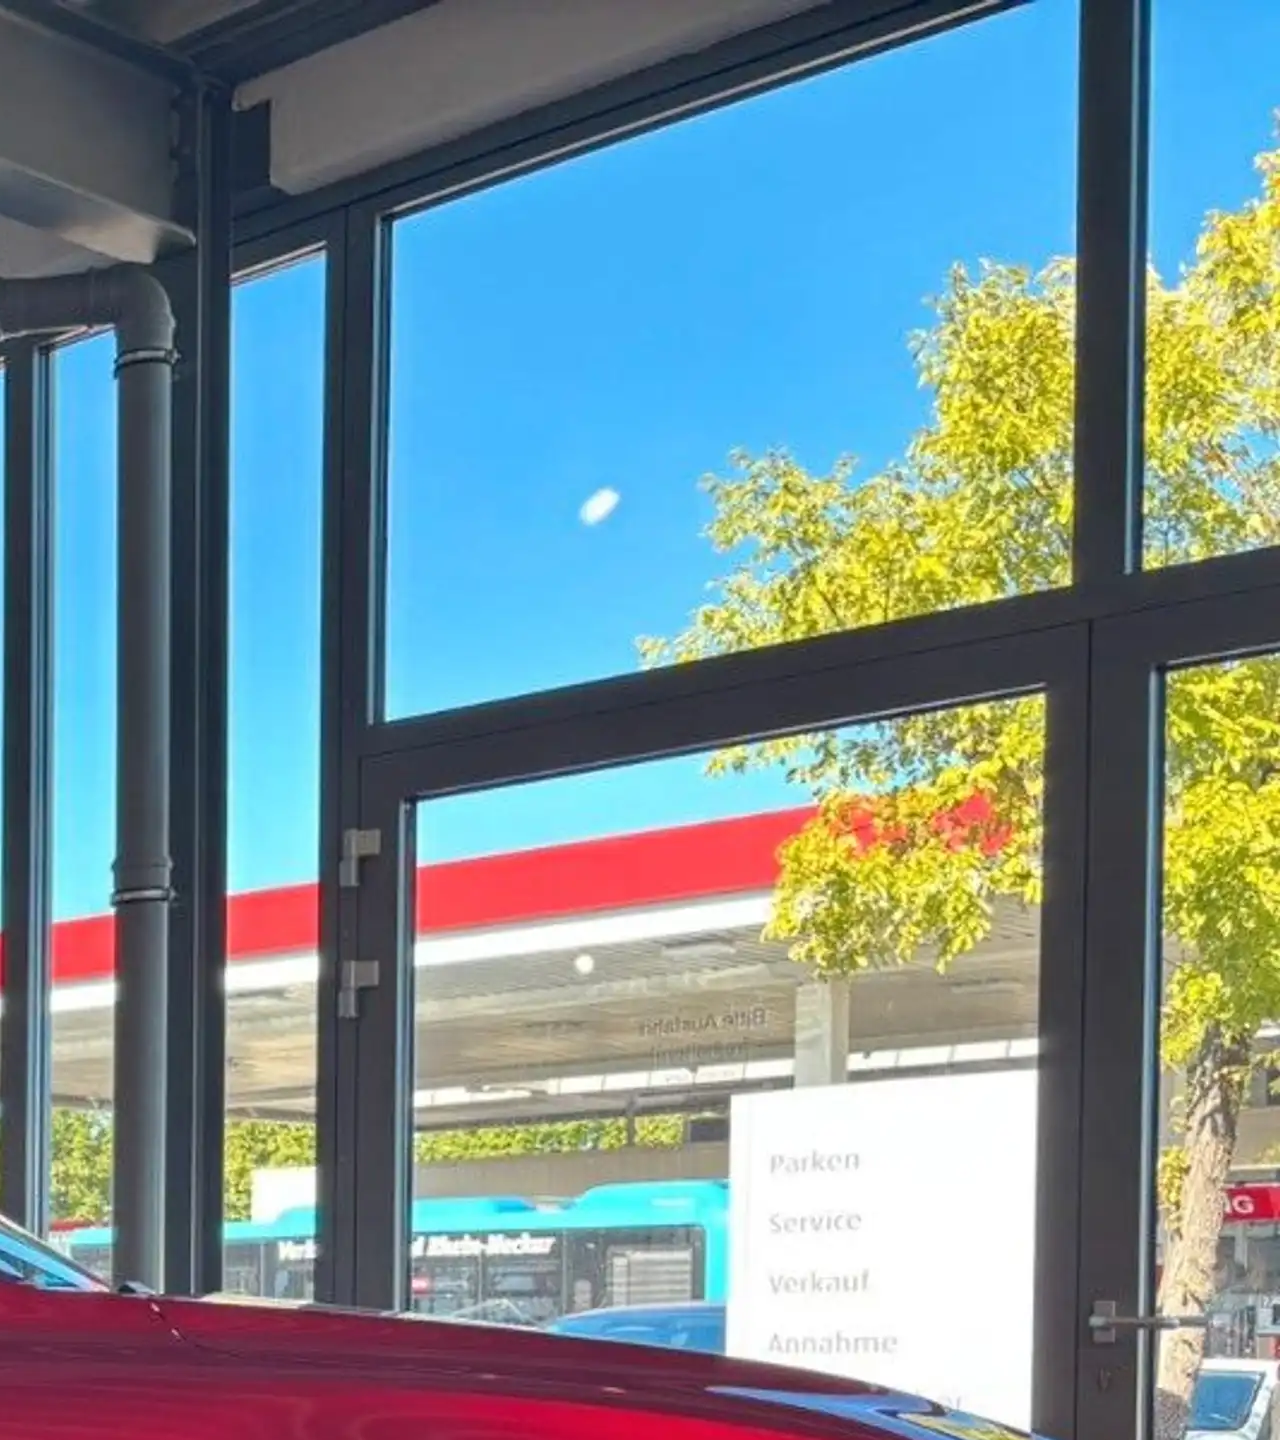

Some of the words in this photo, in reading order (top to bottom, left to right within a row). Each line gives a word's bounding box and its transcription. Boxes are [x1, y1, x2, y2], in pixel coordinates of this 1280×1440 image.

[769, 1149, 861, 1175] Parken
[768, 1210, 863, 1234] Service
[768, 1268, 871, 1294] Verkauf
[768, 1331, 899, 1355] Annahme
